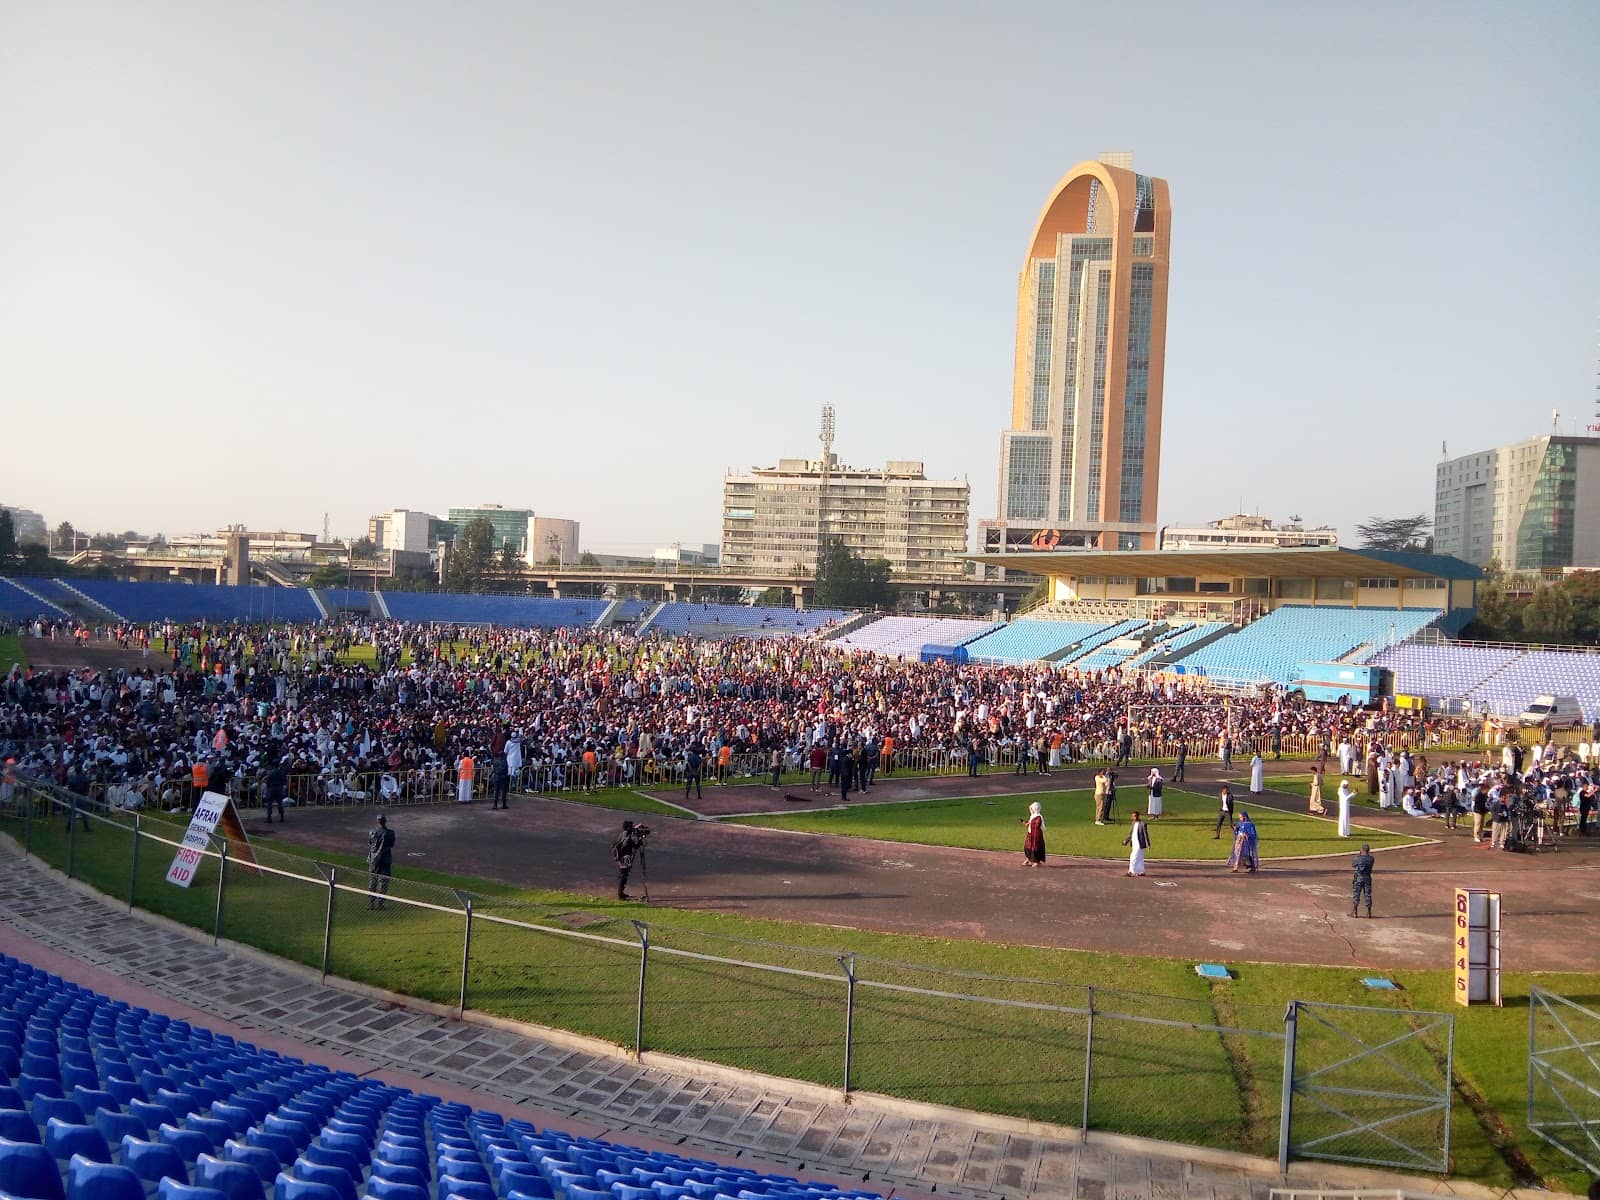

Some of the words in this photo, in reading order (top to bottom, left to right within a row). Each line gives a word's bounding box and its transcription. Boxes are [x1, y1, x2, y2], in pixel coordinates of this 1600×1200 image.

[194, 808, 219, 824] AFRAN
[176, 847, 202, 865] FIRST
[171, 867, 190, 881] AID
